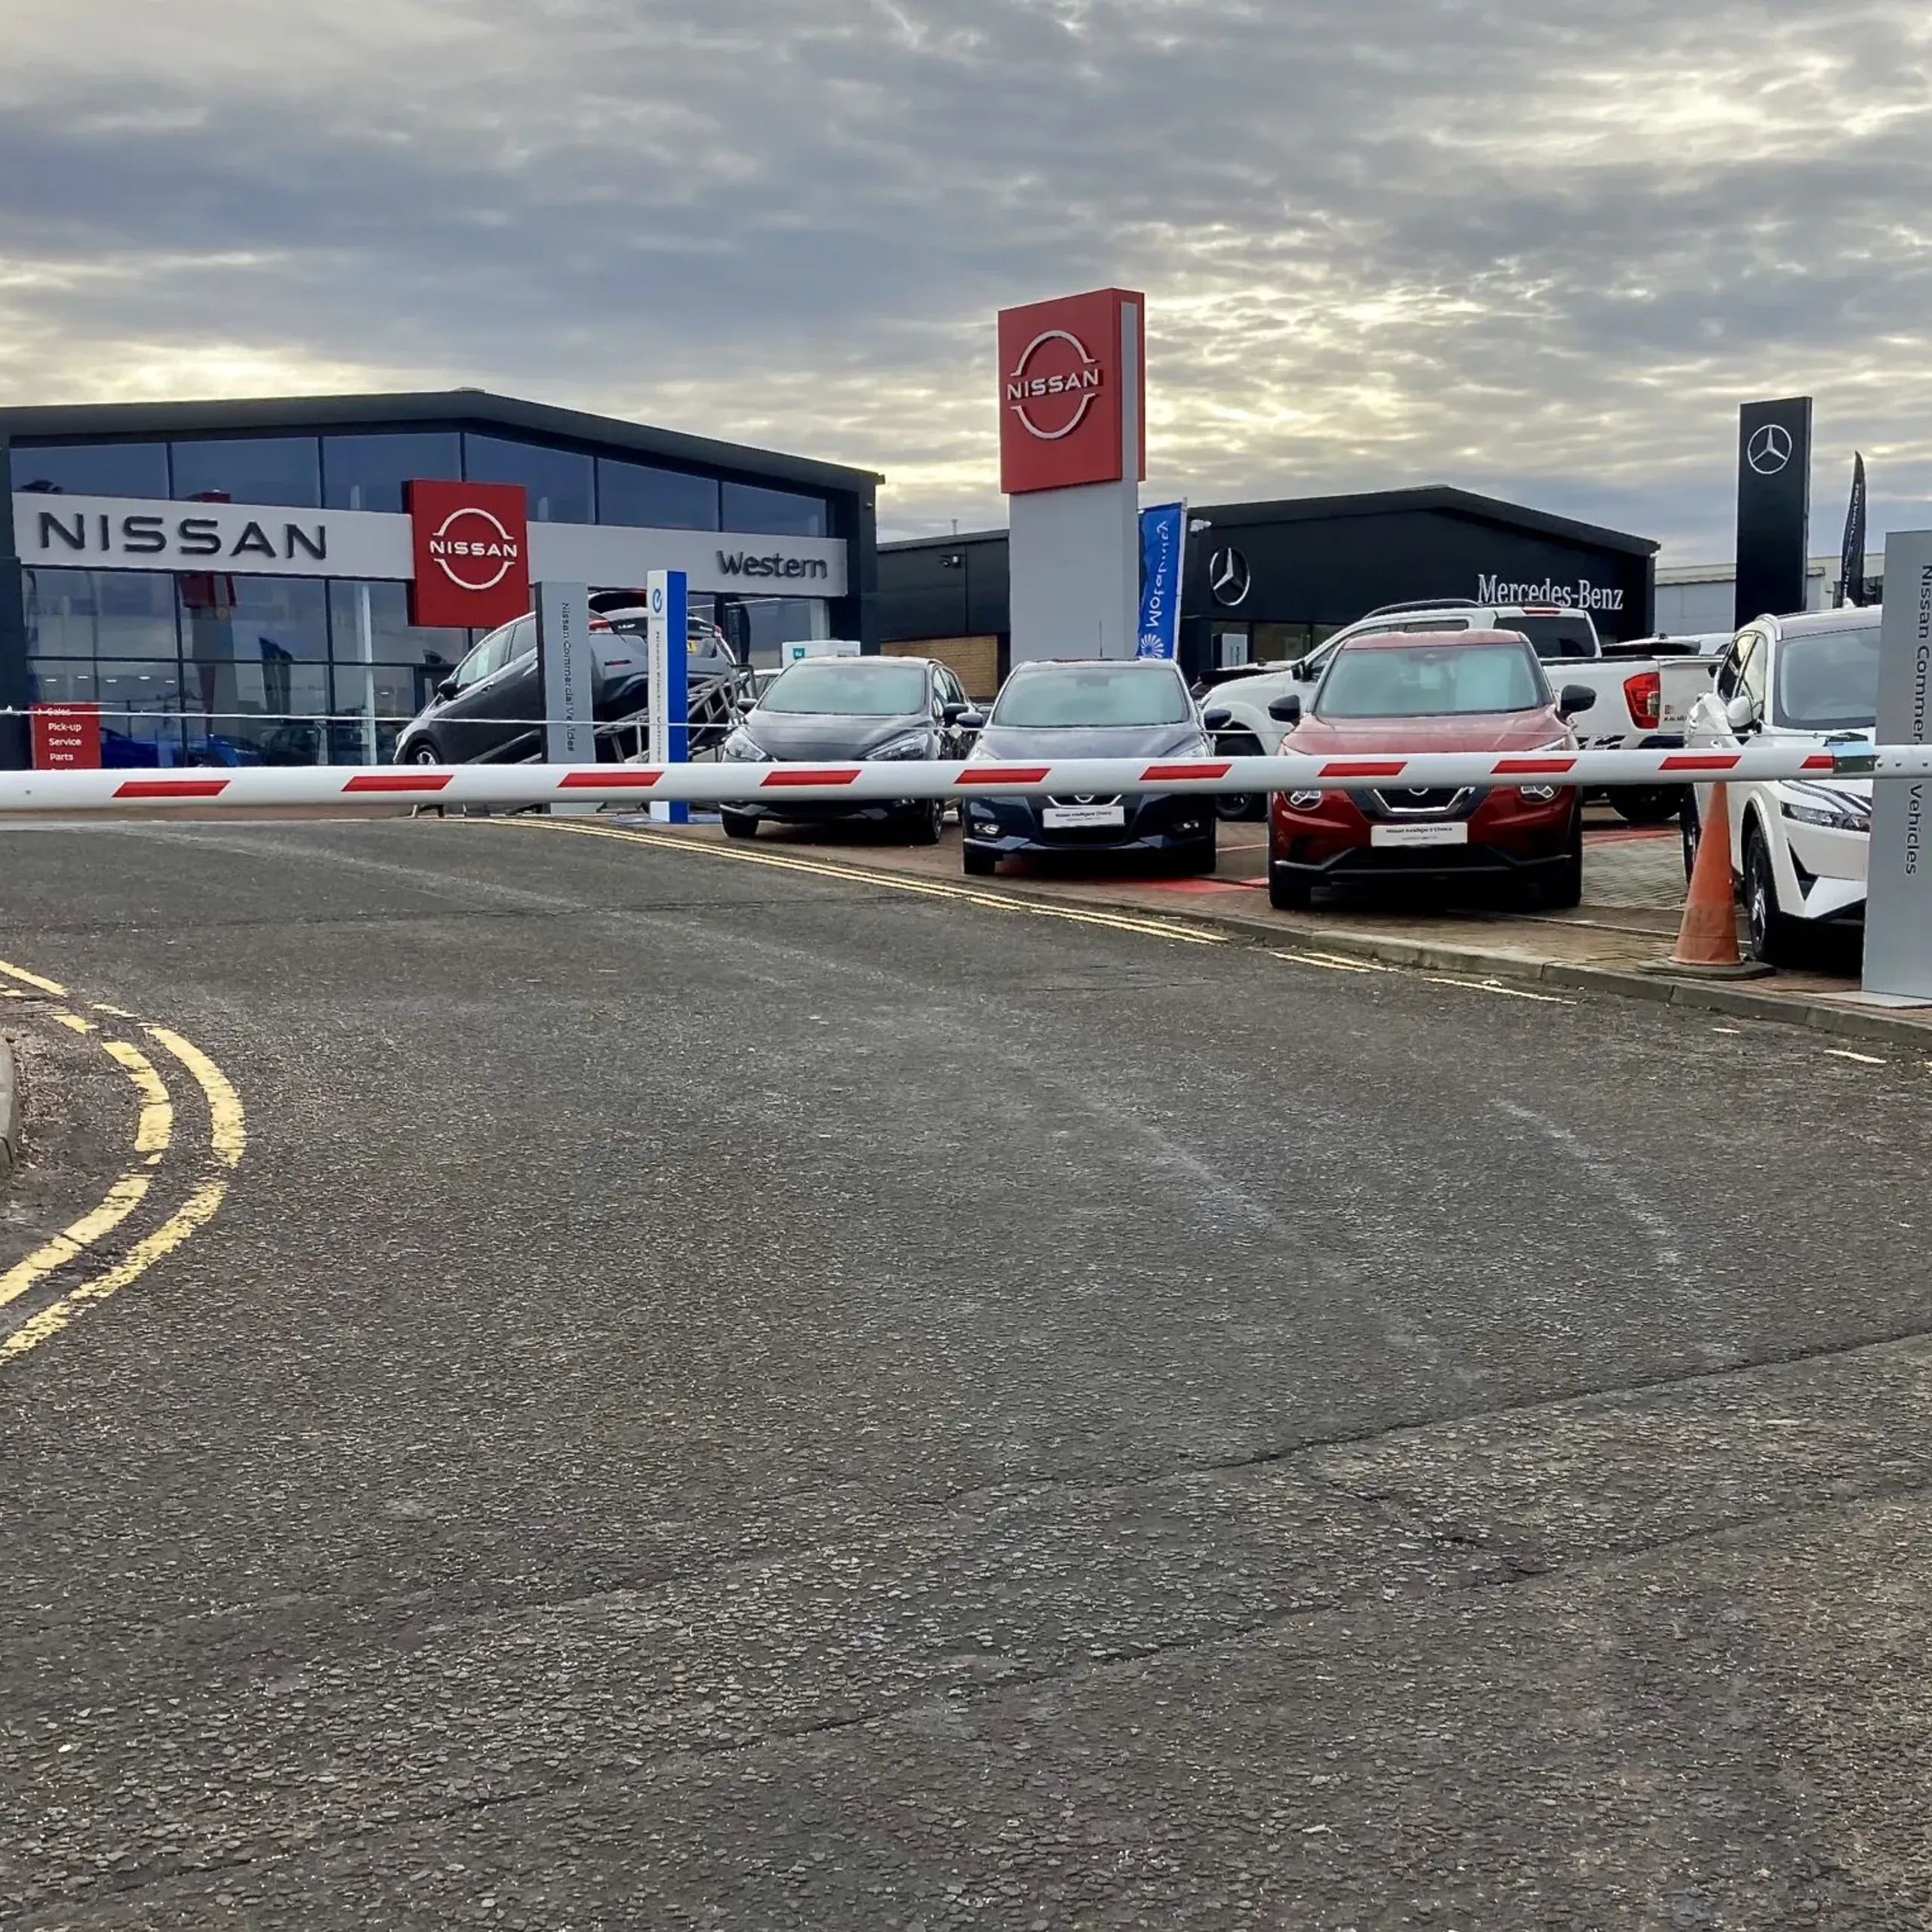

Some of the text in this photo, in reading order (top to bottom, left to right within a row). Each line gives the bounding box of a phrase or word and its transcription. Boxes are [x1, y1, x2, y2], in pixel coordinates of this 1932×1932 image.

[1007, 368, 1099, 401] NISSAN
[38, 511, 328, 560] NISSAN
[429, 540, 518, 557] NISSAN
[716, 550, 829, 580] Western
[1478, 574, 1624, 611] Mercedes-Benz
[561, 602, 571, 639] Nissan
[562, 641, 574, 706] Commercial
[48, 721, 82, 733] Pick-up
[1905, 565, 1932, 875] Nissan Commer Vehicles
[48, 737, 82, 746] Service
[49, 753, 74, 761] Parts
